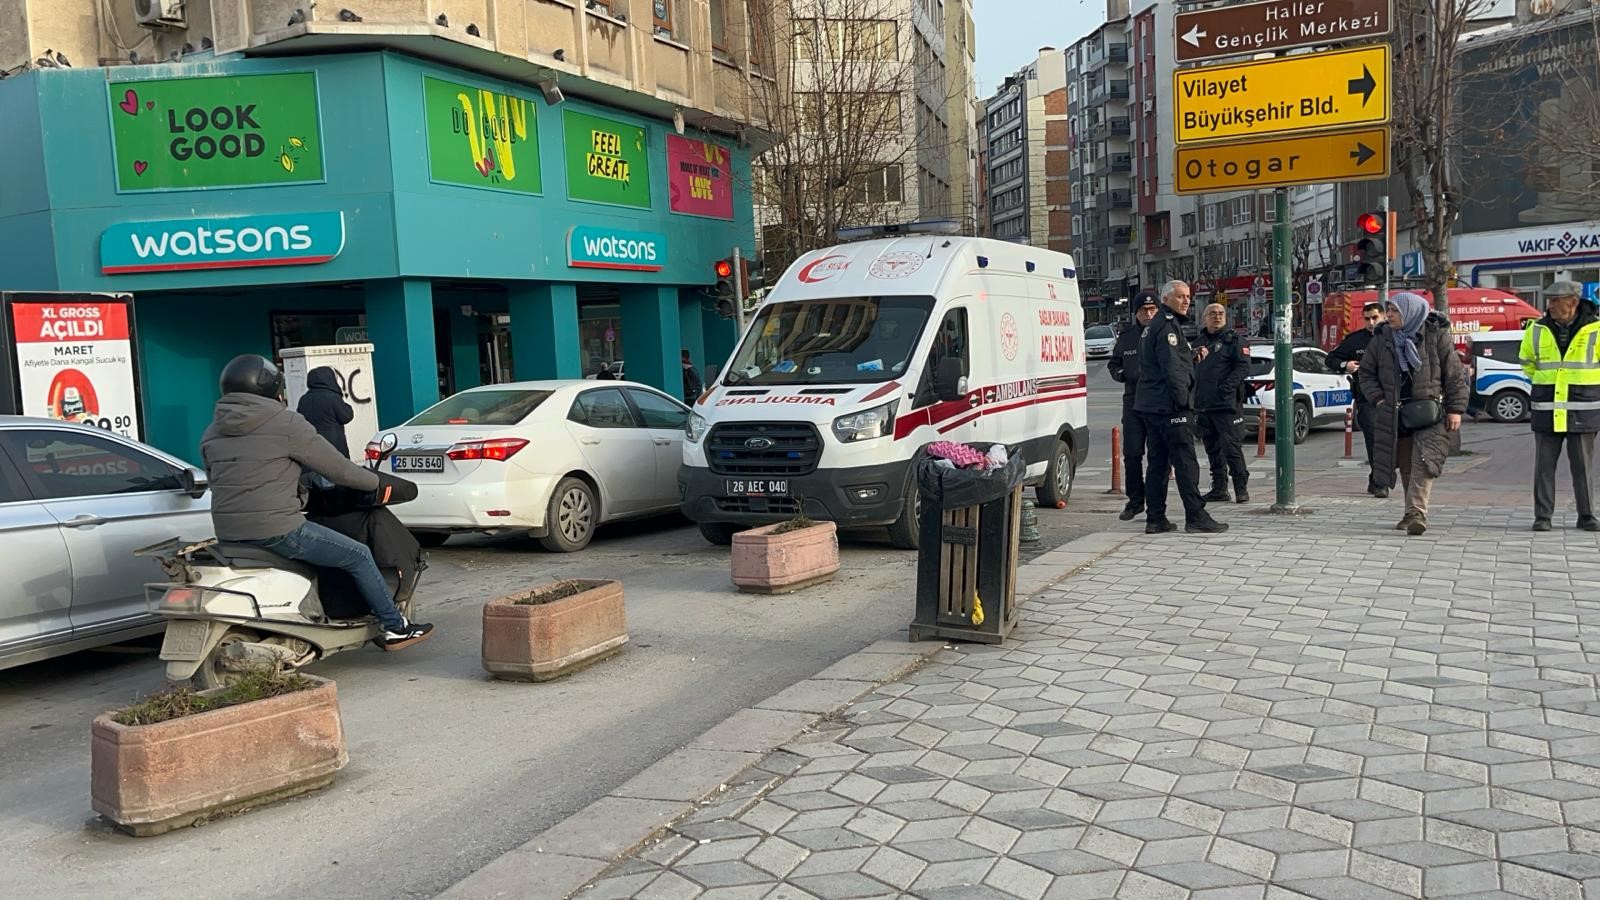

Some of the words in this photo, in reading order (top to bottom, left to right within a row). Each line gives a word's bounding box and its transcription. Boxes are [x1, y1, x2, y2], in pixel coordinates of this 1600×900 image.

[1266, 2, 1324, 21] Haller
[1215, 27, 1289, 48] Gençlik
[1300, 11, 1379, 37] Merkezi
[1183, 75, 1247, 99] Vilayet
[168, 104, 261, 133] LOOK
[1184, 101, 1294, 131] Büyükşehir
[1300, 96, 1339, 116] Bld.
[170, 133, 265, 161] GOOD
[594, 132, 619, 155] FEEL
[588, 154, 627, 180] GREAT
[1185, 155, 1300, 180] Otogar
[131, 225, 312, 258] watsons
[583, 235, 656, 261] watsons
[1518, 238, 1556, 253] VAKIF
[42, 308, 57, 318] XL
[60, 307, 100, 318] GROSS
[40, 320, 104, 340] AÇILDI
[50, 358, 69, 366] Dana
[71, 357, 94, 366] Kangal
[96, 356, 116, 364] Sucuk
[54, 345, 94, 356] MARET
[995, 379, 1038, 402] AMBULANS
[114, 415, 131, 428] 90
[396, 457, 407, 468] 26
[411, 457, 423, 468] US
[425, 457, 442, 468] 640
[733, 481, 744, 492] 26
[748, 481, 764, 492] AEC
[769, 481, 786, 492] 040
